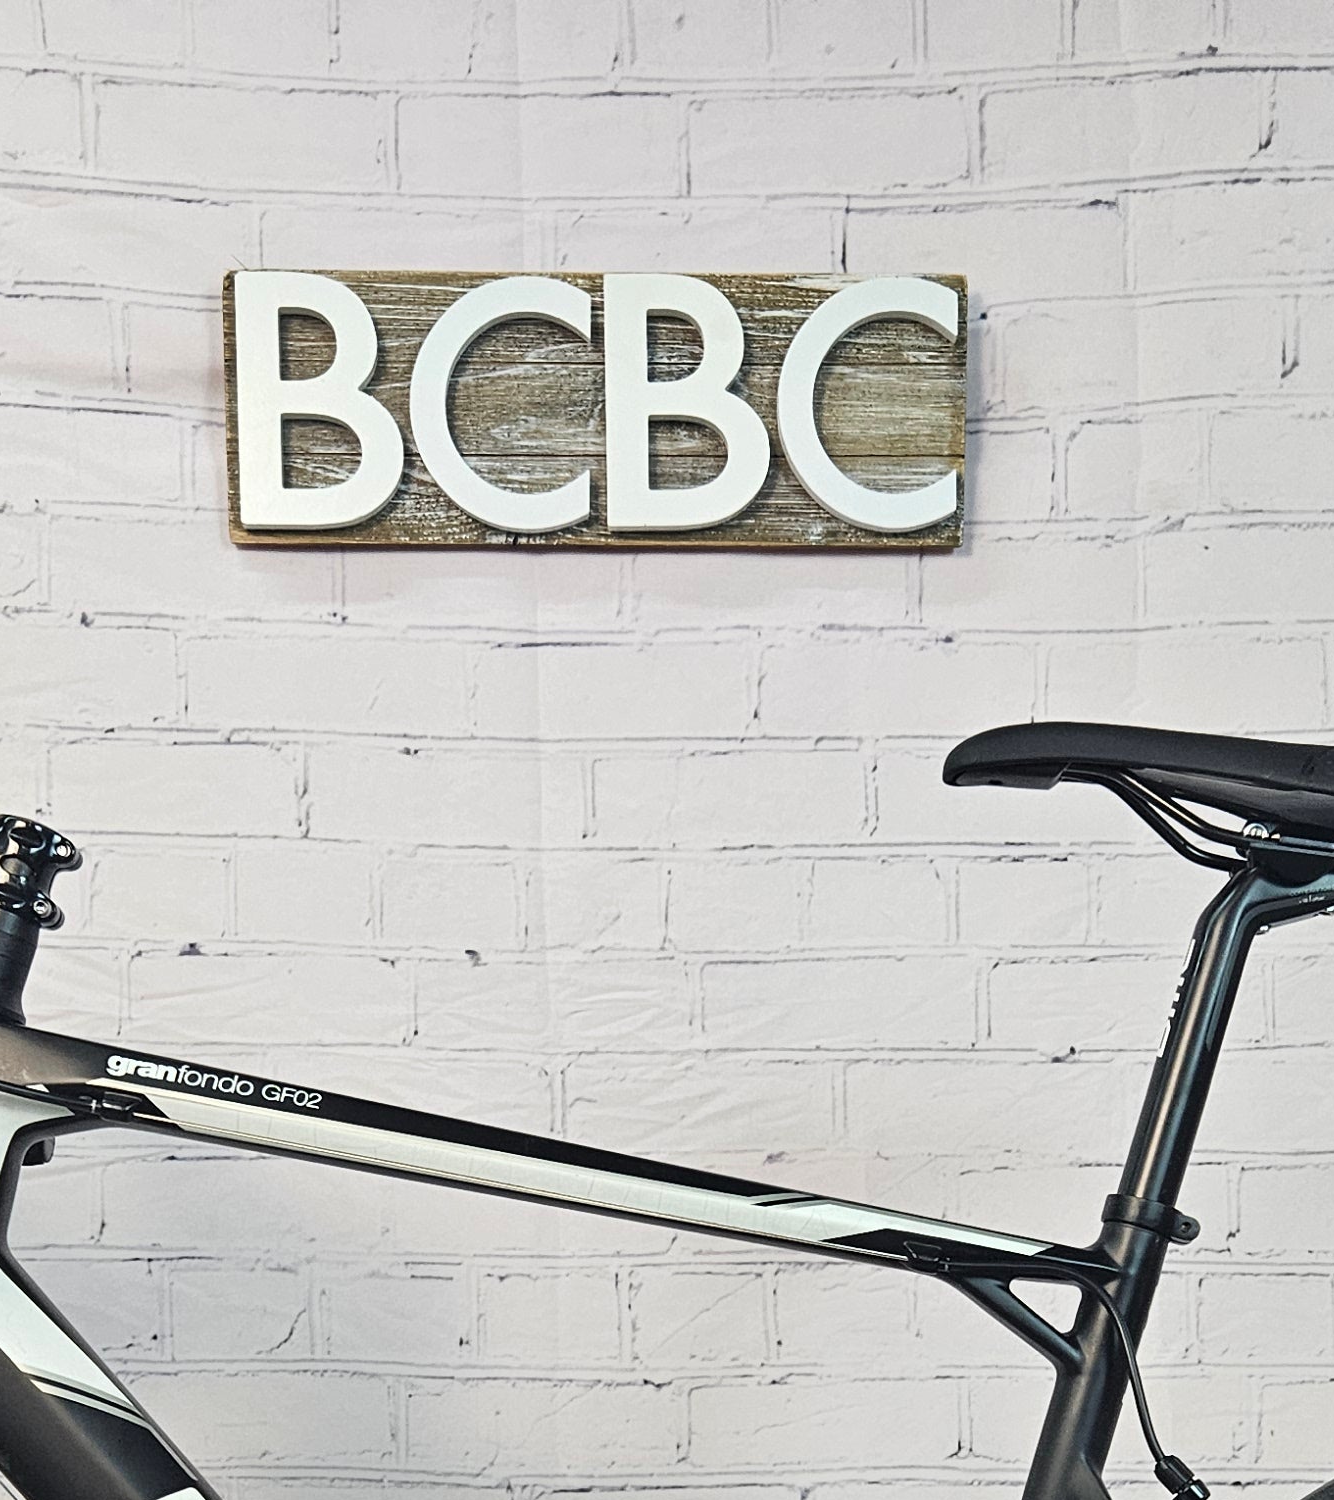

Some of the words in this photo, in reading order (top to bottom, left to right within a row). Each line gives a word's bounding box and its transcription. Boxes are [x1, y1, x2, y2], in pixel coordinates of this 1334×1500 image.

[235, 271, 958, 533] BCBC
[105, 1054, 254, 1096] granfondo
[261, 1083, 323, 1110] GF02
